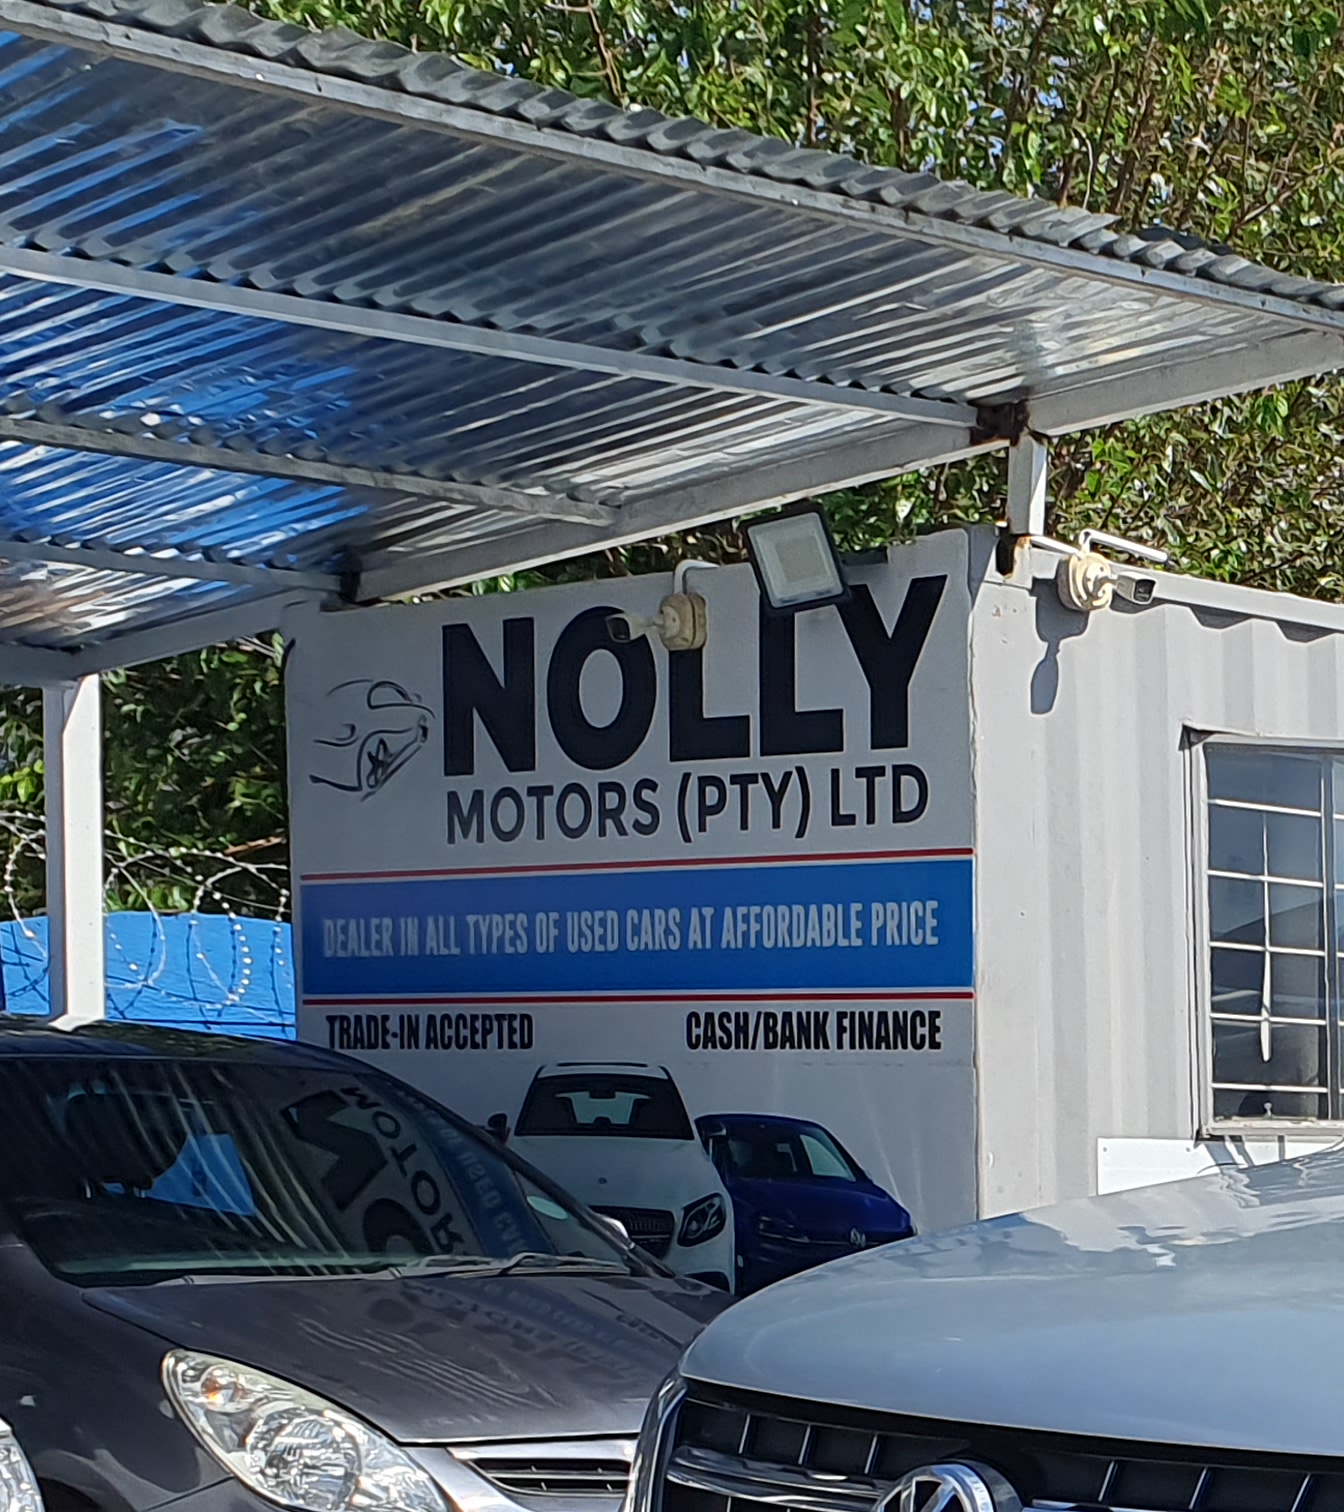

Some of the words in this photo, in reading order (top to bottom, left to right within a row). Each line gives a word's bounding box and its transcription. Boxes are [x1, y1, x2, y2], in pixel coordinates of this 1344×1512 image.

[441, 574, 948, 776] NOLLY
[446, 777, 660, 845] MOTORS
[677, 766, 811, 842] (PTY)
[831, 763, 930, 827] LTD
[322, 917, 395, 958] DEALER
[399, 916, 420, 956] IN
[425, 915, 462, 956] ALL
[466, 913, 529, 954] TYPES
[535, 911, 560, 953] OF
[565, 910, 620, 953] USED
[625, 908, 683, 952] CARS
[688, 906, 717, 949] AT
[721, 902, 864, 950] AFFORDABLE
[871, 899, 940, 946] PRICE
[326, 1013, 420, 1050] TRADE-IN
[425, 1012, 535, 1050] ACCEPTED
[686, 1010, 831, 1051] CASH/BANK
[836, 1009, 943, 1051] FINANCE
